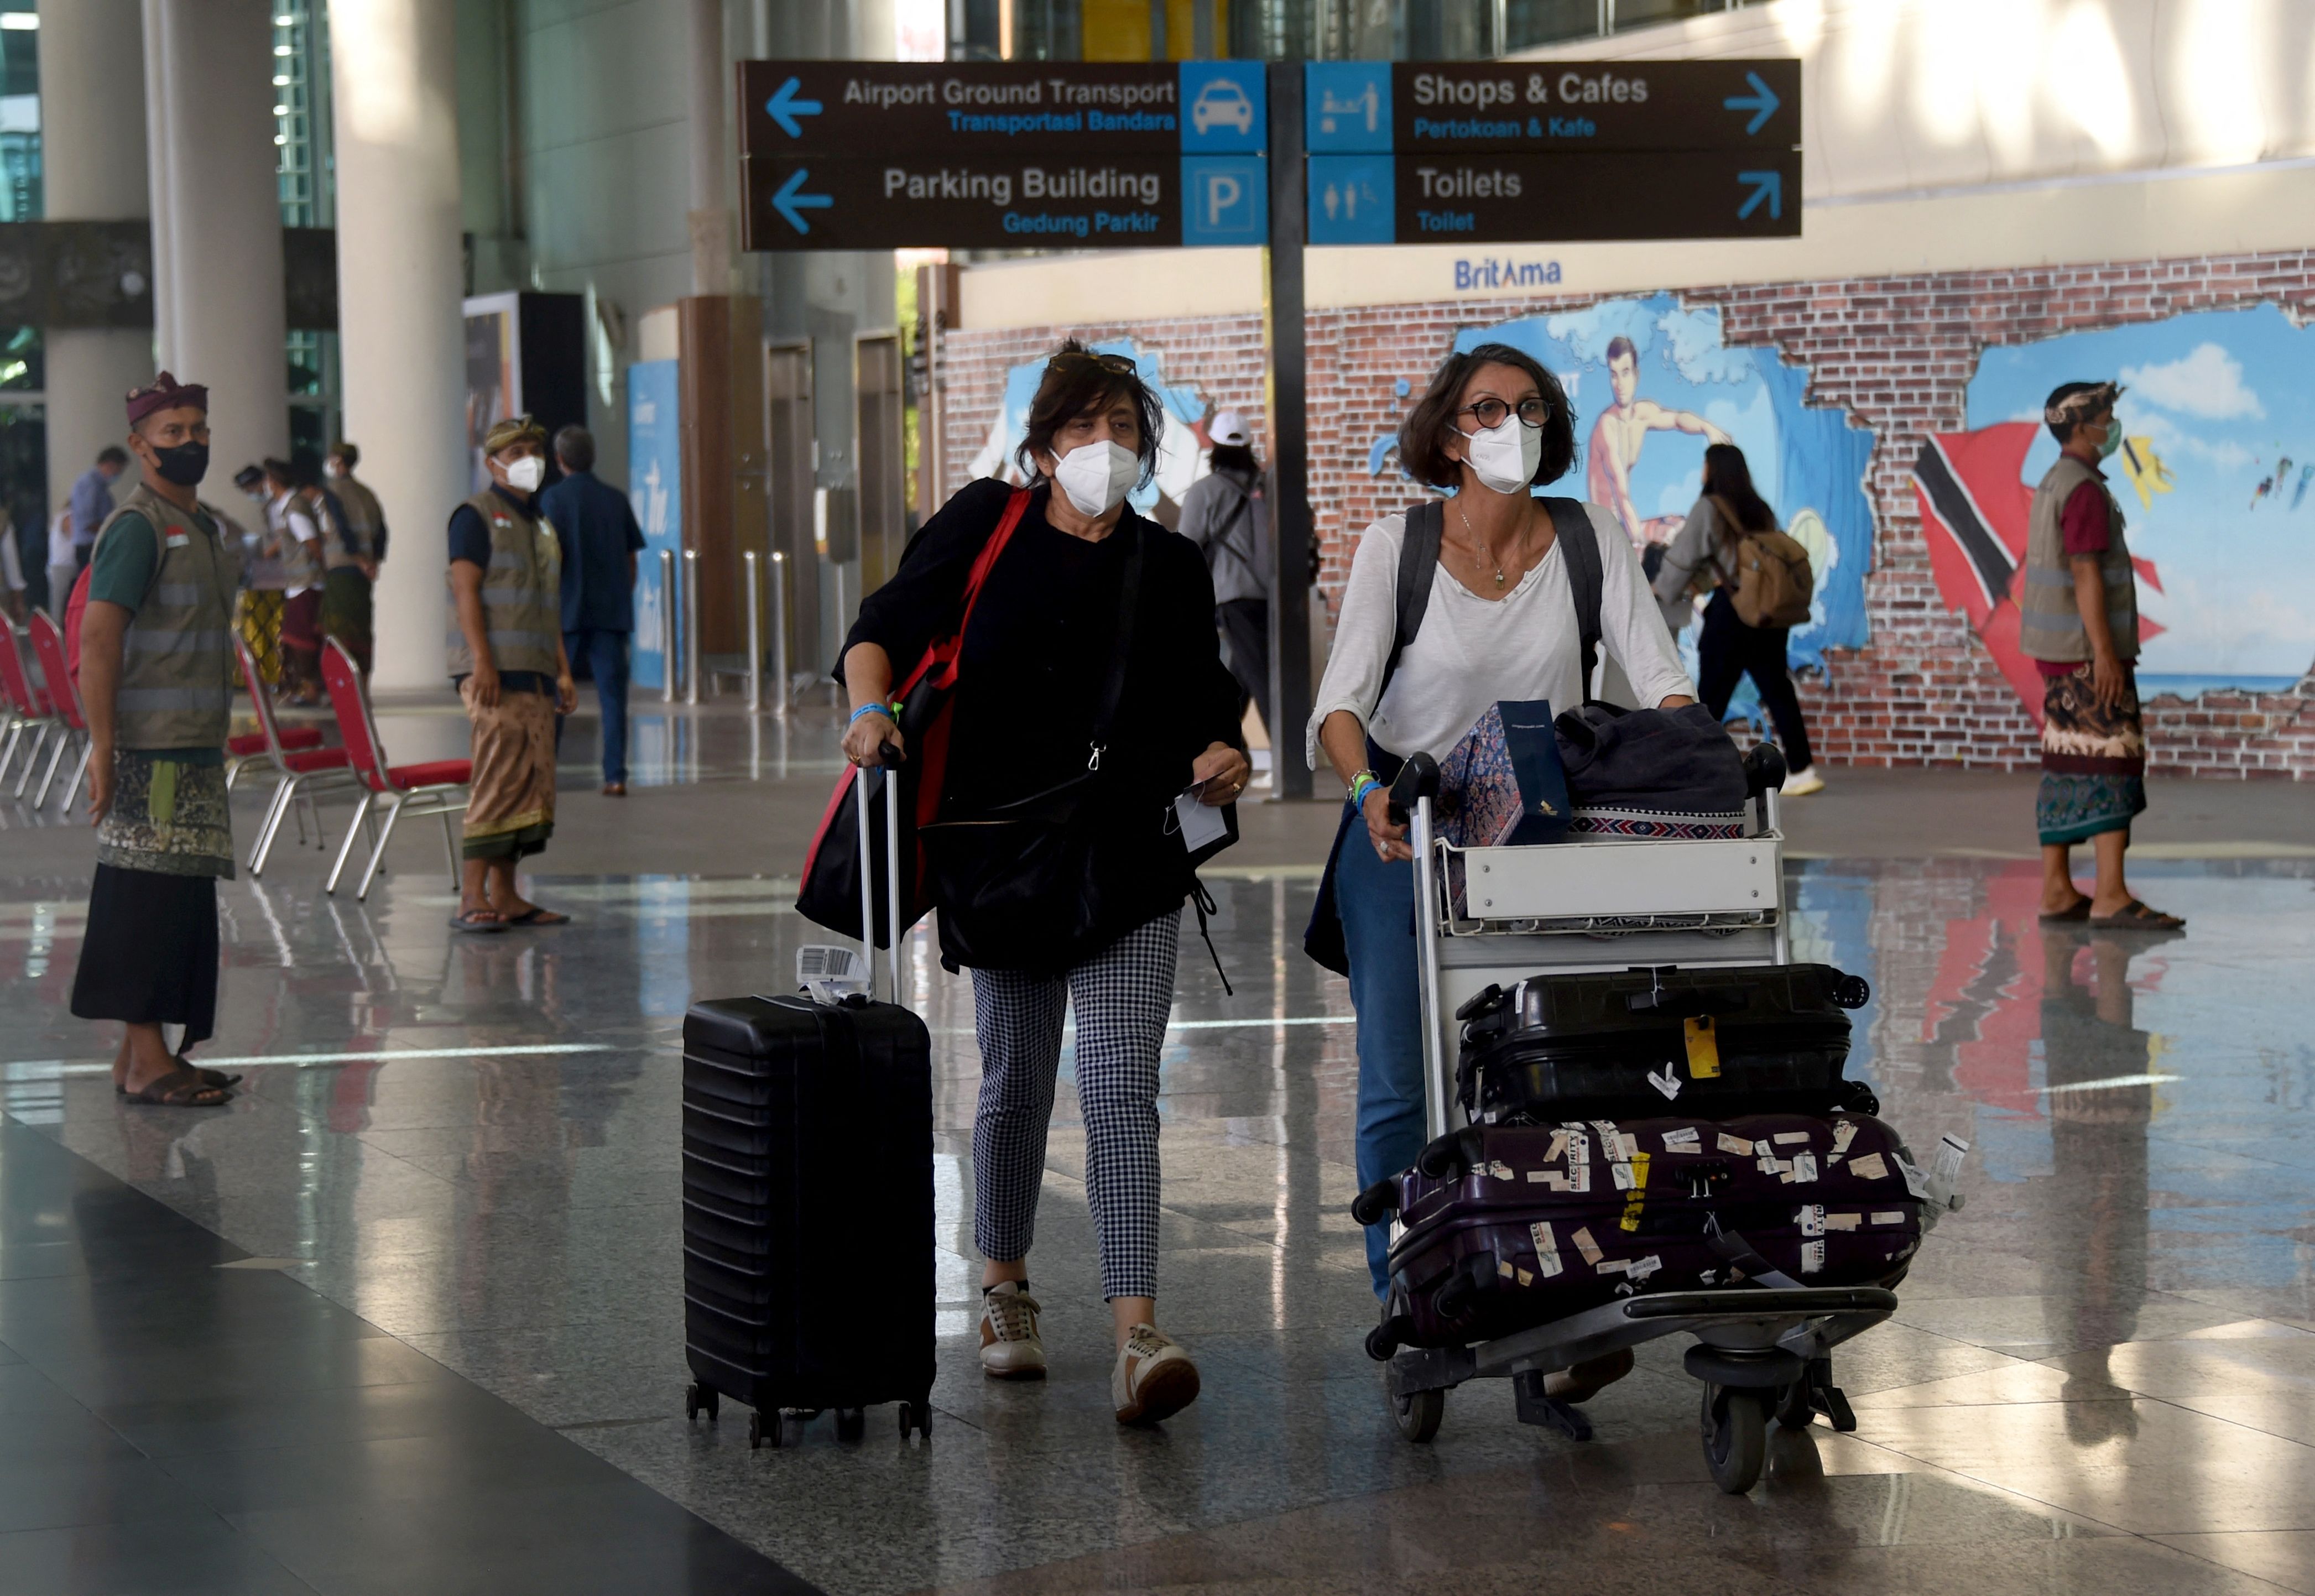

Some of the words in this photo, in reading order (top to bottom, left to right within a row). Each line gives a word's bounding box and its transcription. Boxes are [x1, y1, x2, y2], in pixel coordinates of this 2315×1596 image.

[844, 79, 935, 110] Airport
[943, 80, 1041, 105] Ground
[1049, 79, 1175, 109] Transport
[1414, 74, 1515, 110] Shops
[1526, 74, 1547, 103] &
[1558, 72, 1649, 104] Cafes
[948, 111, 1081, 135] Transportasi
[1088, 111, 1175, 131] Bandara
[1414, 118, 1521, 138] Pertokoan
[1527, 118, 1542, 138] &
[1548, 118, 1596, 138] Kafe
[885, 169, 1011, 206] Parking
[1023, 168, 1160, 205] Building
[1417, 168, 1522, 198] Toilets
[1209, 177, 1240, 225] P
[1003, 212, 1088, 237] Gedung
[1094, 211, 1158, 232] Parkir
[1417, 211, 1474, 232] Toilet
